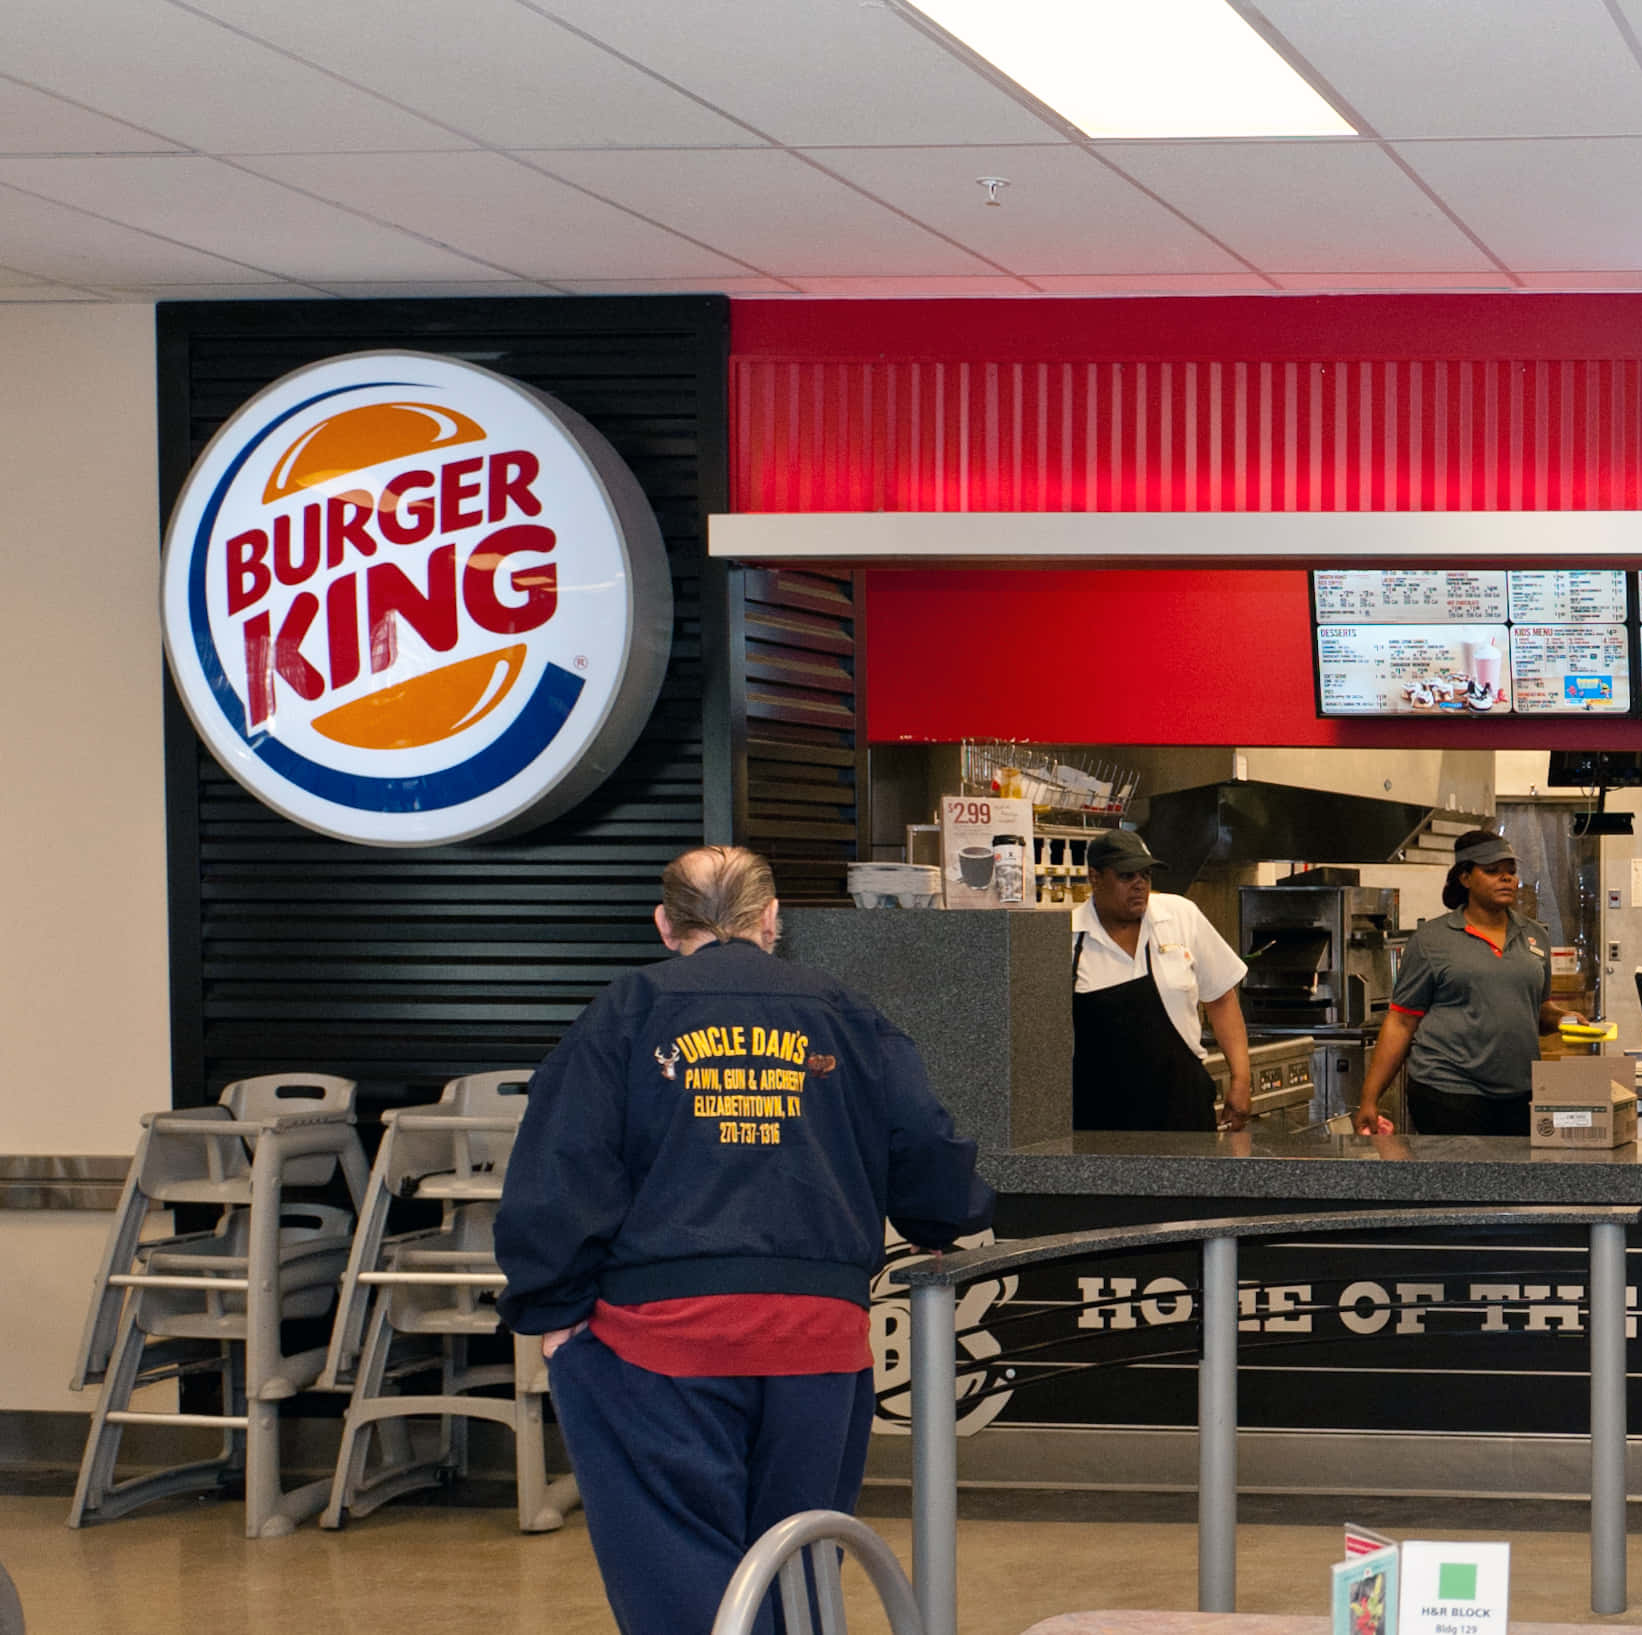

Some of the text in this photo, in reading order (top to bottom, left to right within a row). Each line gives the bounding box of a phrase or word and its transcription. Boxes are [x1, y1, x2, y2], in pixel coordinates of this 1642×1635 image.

[226, 450, 543, 616] BURGER
[243, 524, 558, 728] KING
[676, 1026, 808, 1064] UNCLE DAN'S
[685, 1068, 806, 1093] PAWN, GUN & ARCHERY
[694, 1095, 801, 1119] ELIZABETHTOWN, KY
[1338, 1281, 1446, 1334] OF
[1470, 1283, 1638, 1338] TH
[1421, 1607, 1491, 1618] H&R BLOCK
[1436, 1625, 1477, 1635] Bldg 129
